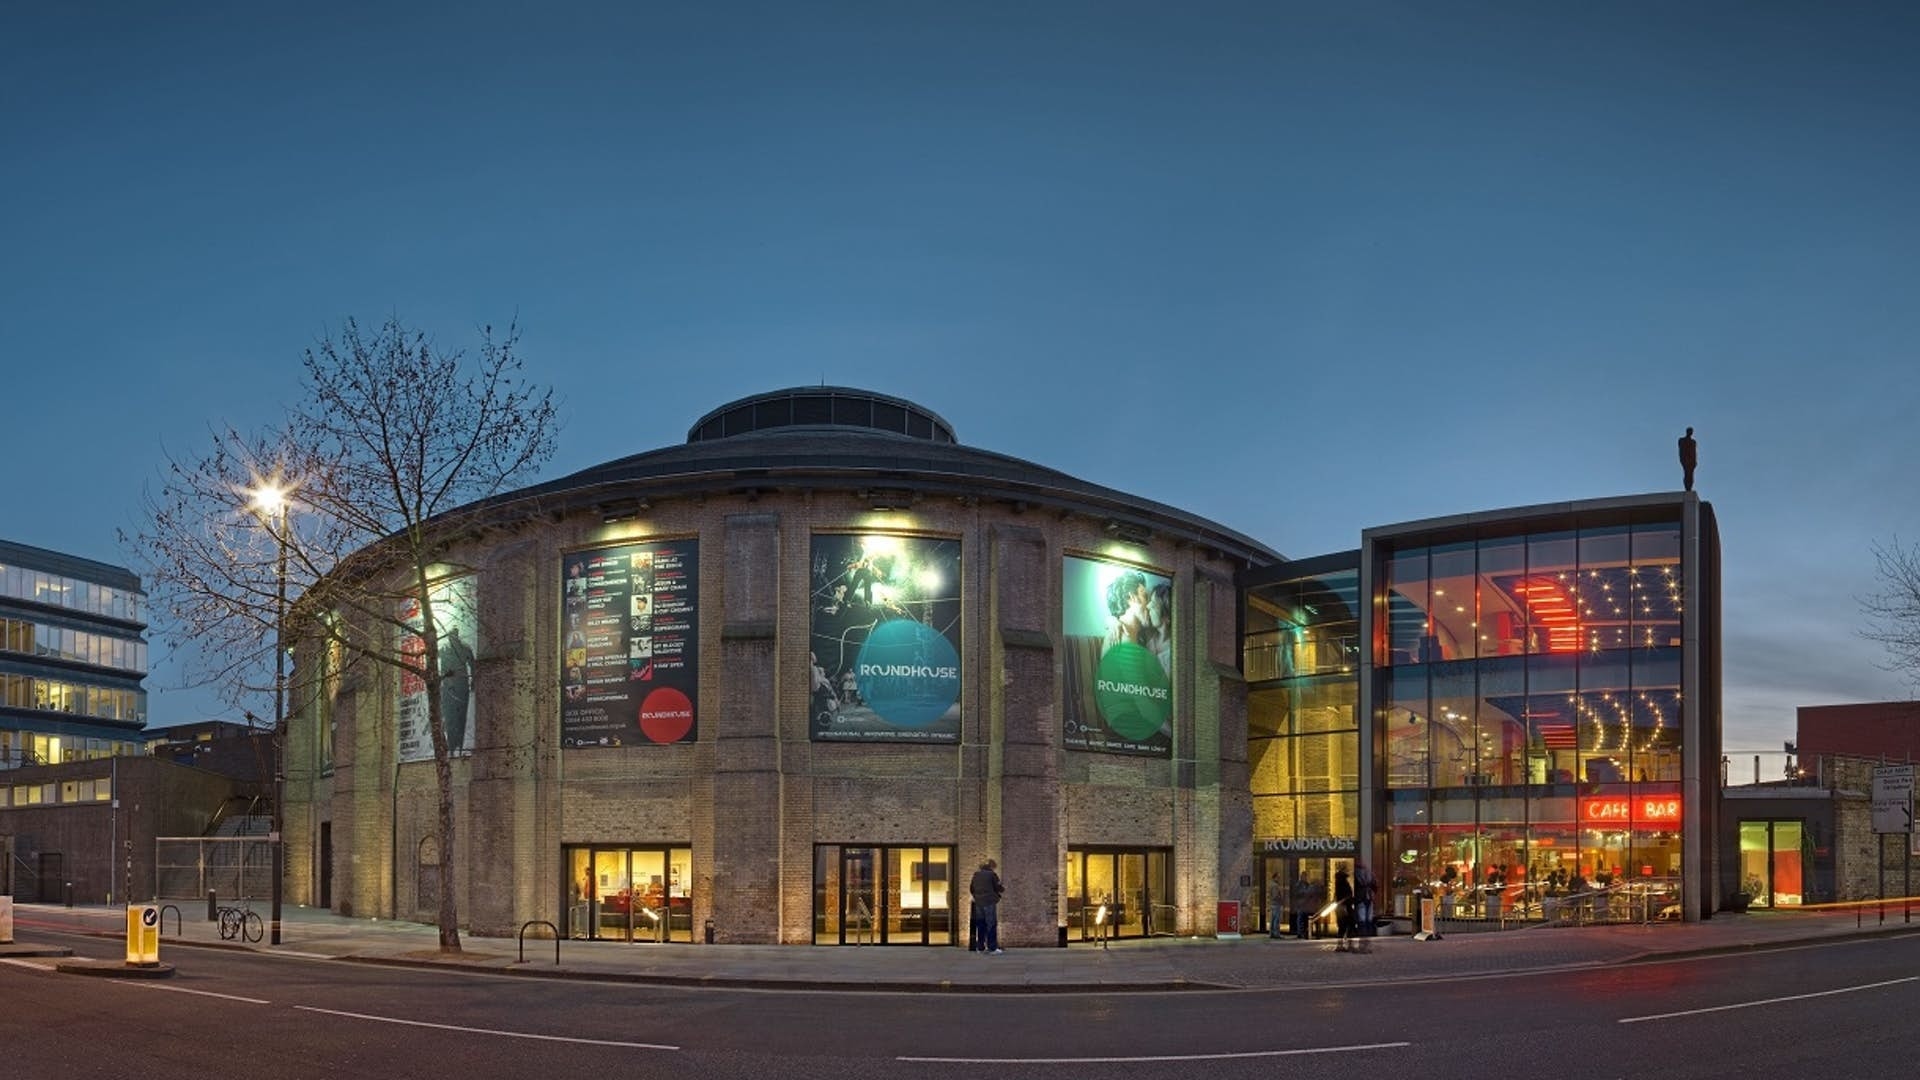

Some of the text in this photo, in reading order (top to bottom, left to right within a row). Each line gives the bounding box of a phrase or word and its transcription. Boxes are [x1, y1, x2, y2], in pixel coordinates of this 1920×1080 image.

[860, 664, 957, 679] ROUNDHOUSE
[1098, 680, 1168, 700] ROUNDHOUSE
[1589, 801, 1678, 818] CAFE BAR
[1264, 837, 1355, 851] ROUNDHOUSE
